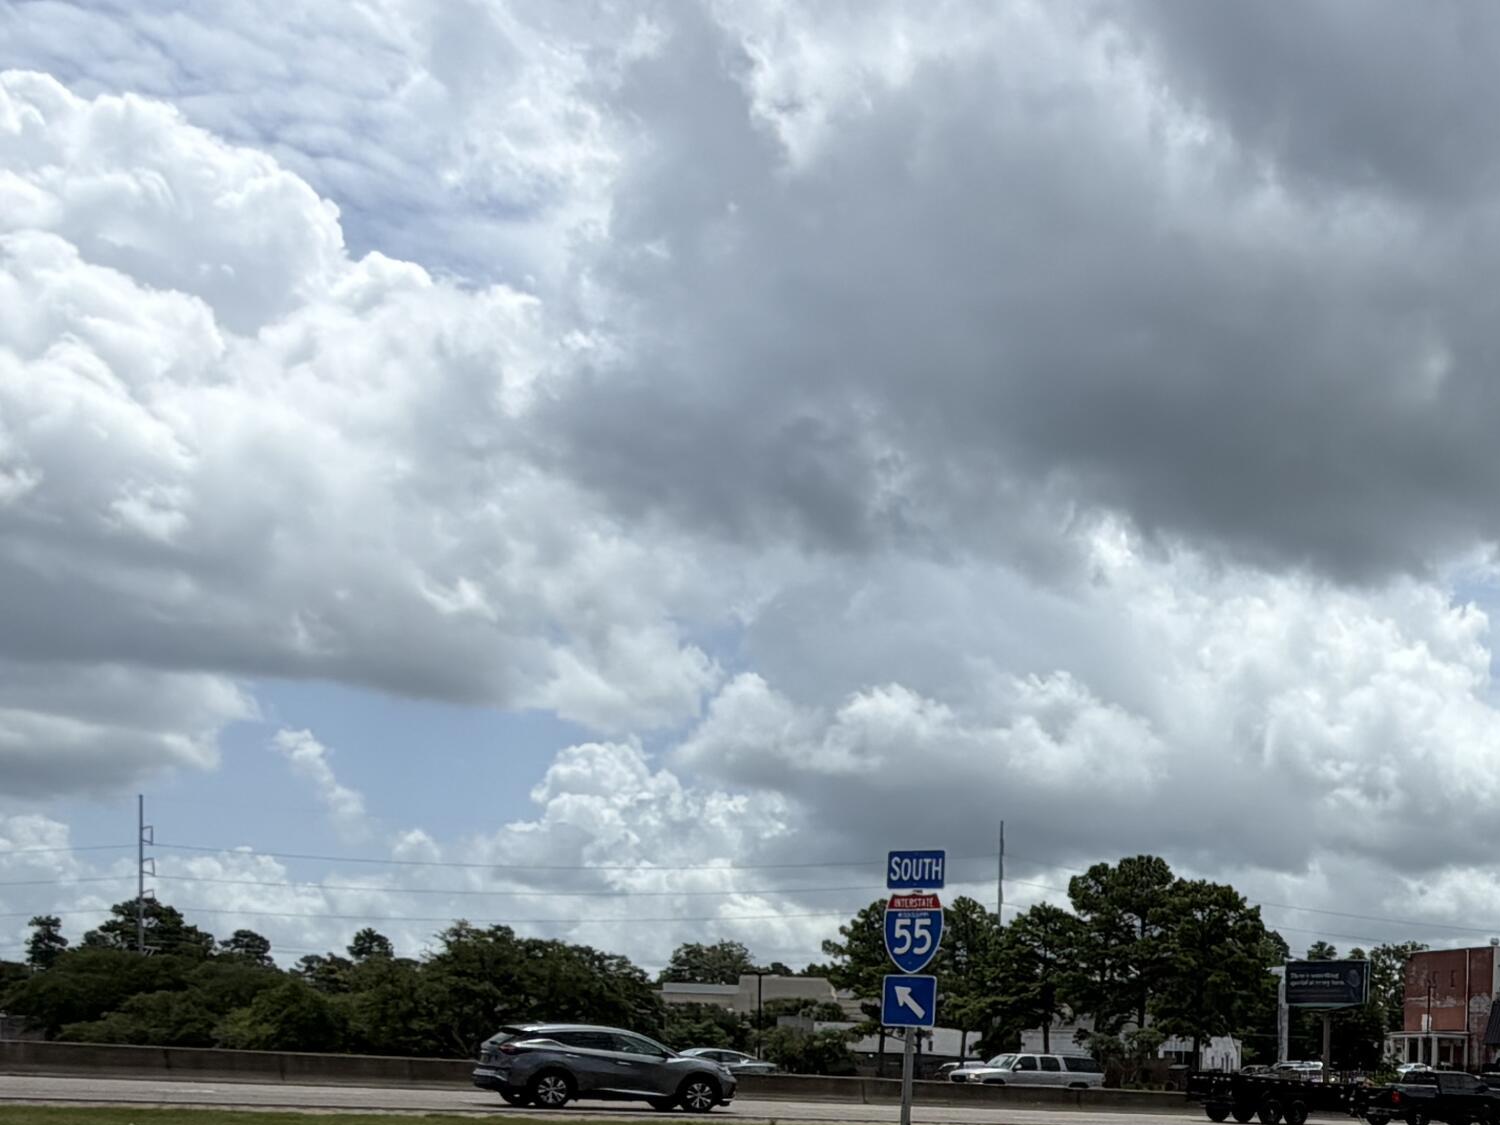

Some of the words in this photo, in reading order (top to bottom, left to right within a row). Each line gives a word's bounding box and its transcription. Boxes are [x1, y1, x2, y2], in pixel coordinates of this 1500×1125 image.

[890, 857, 942, 880] SOUTH
[894, 898, 934, 908] INTERSTATE
[893, 918, 932, 955] 55
